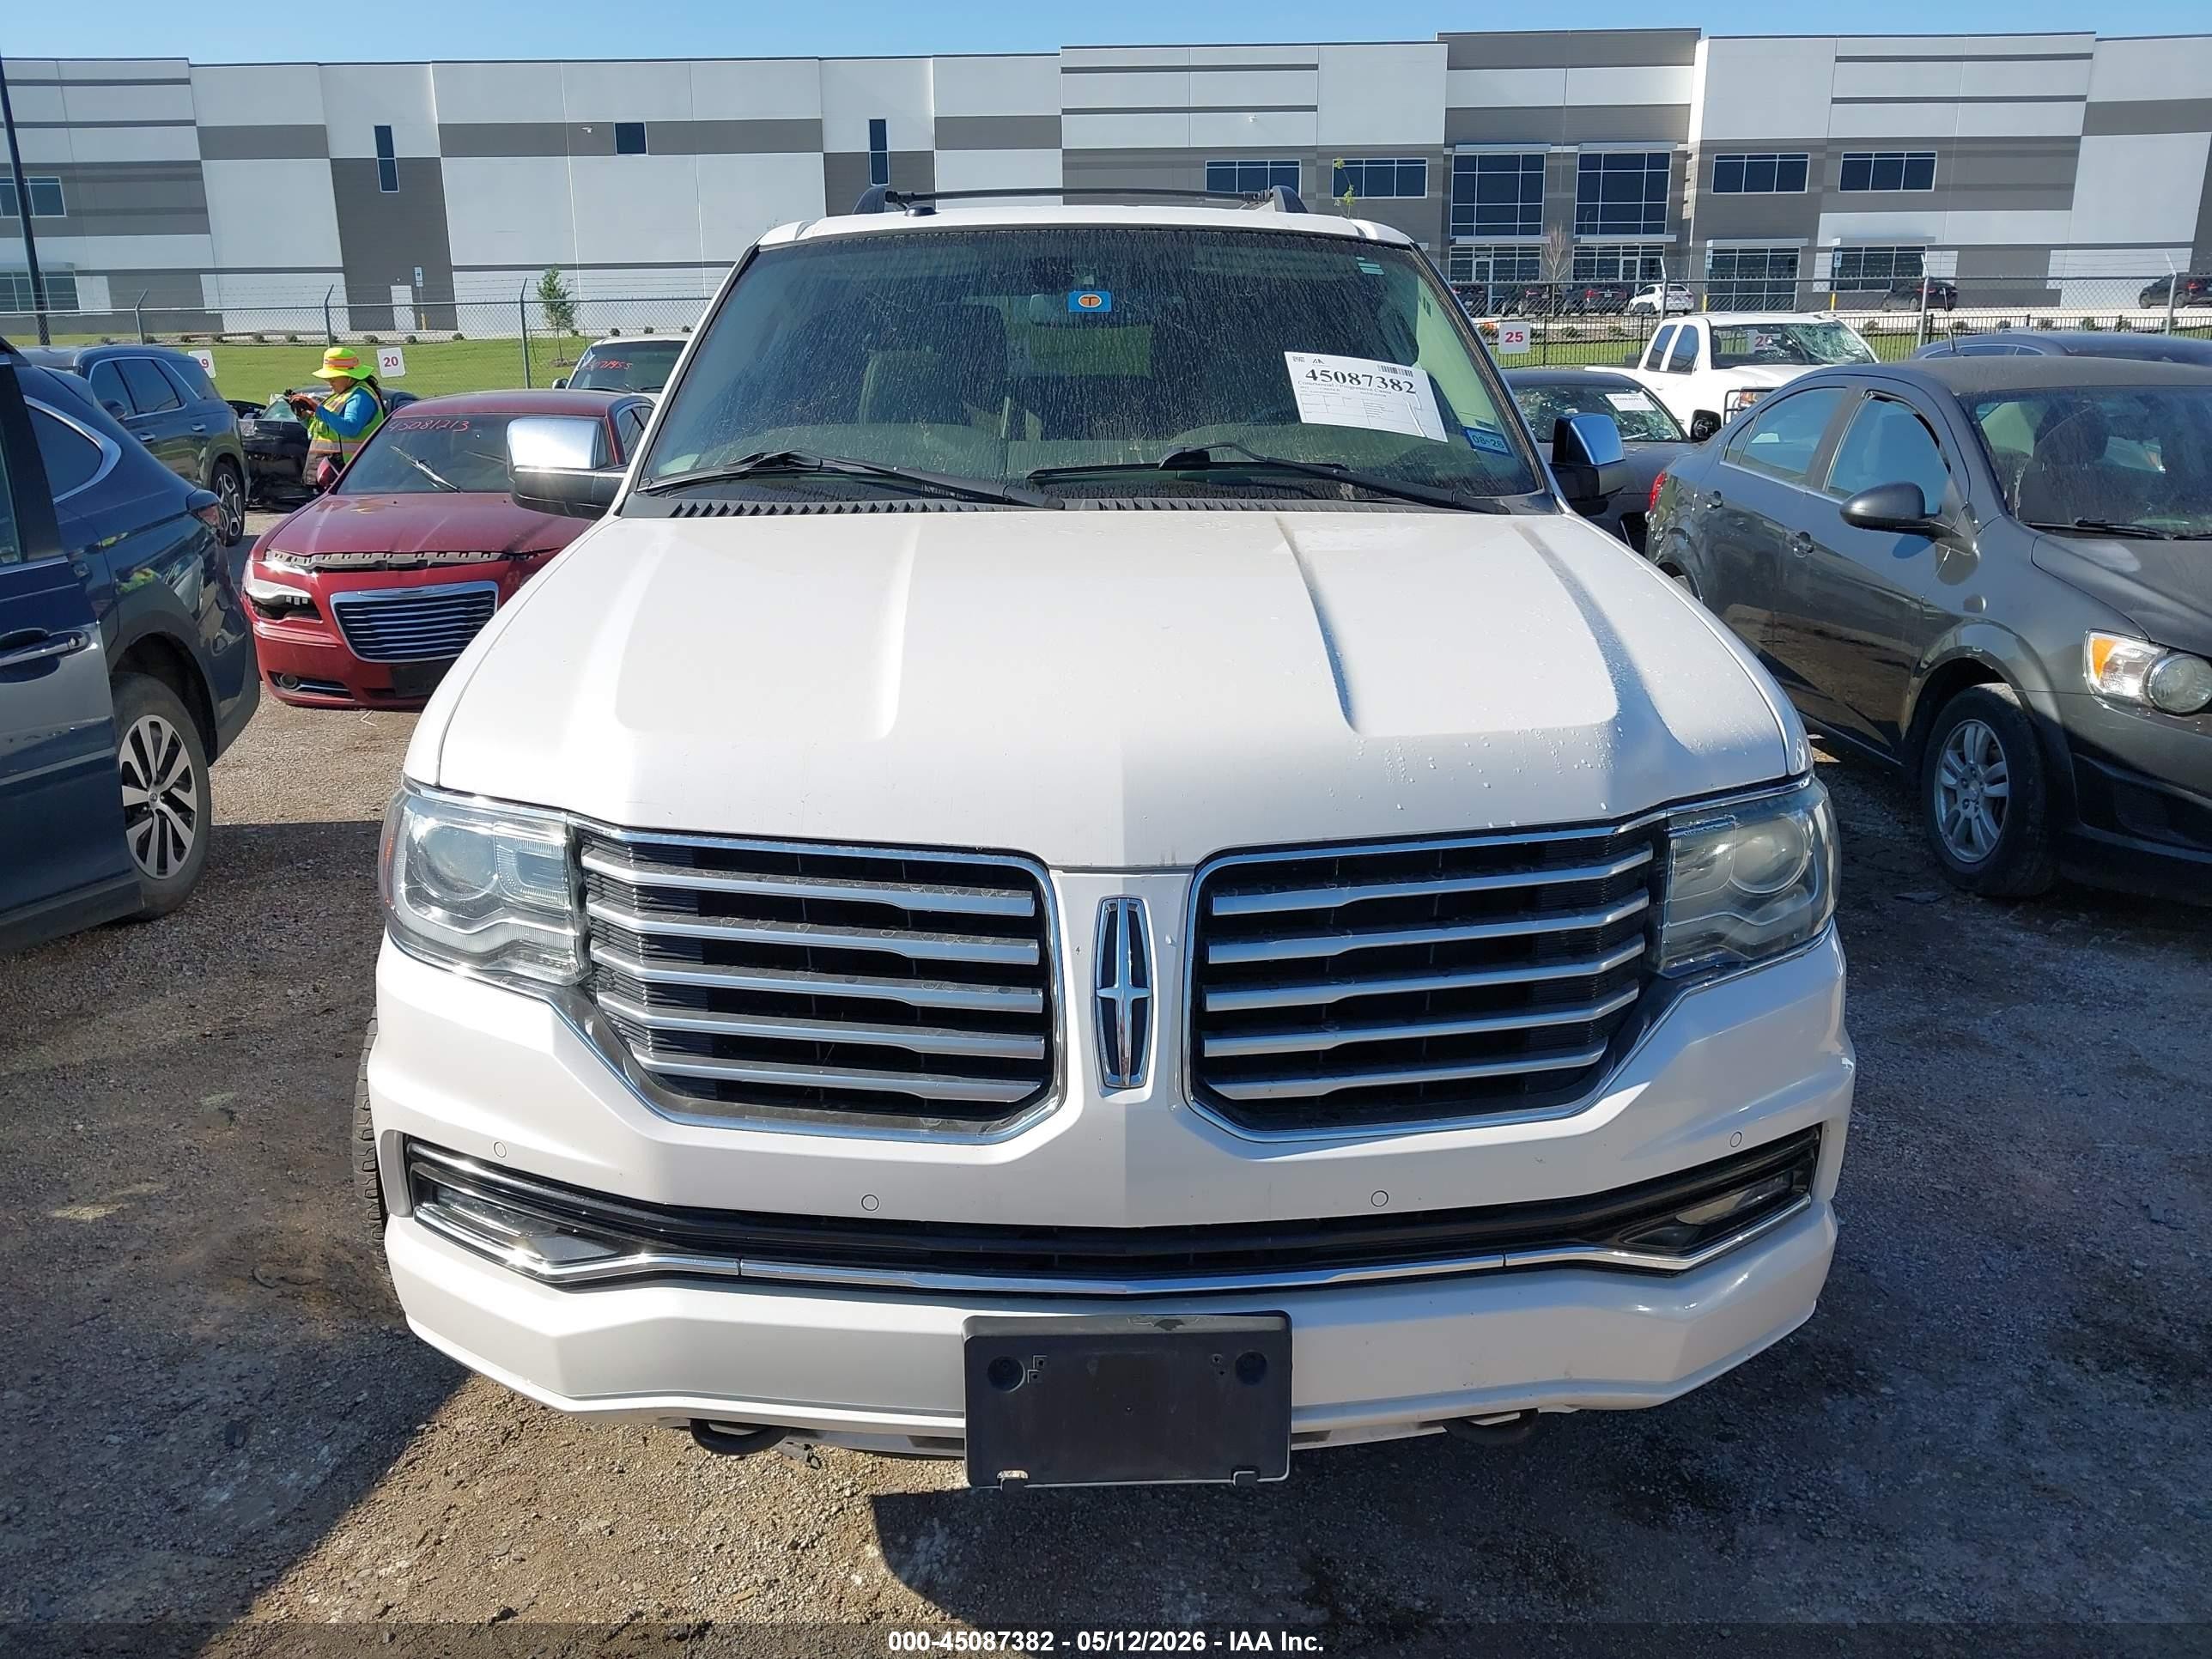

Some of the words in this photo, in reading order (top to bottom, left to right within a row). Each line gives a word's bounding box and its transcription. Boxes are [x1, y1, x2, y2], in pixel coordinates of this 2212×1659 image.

[1504, 331, 1524, 343] 25
[383, 356, 399, 368] 20
[1305, 368, 1416, 394] 45087382
